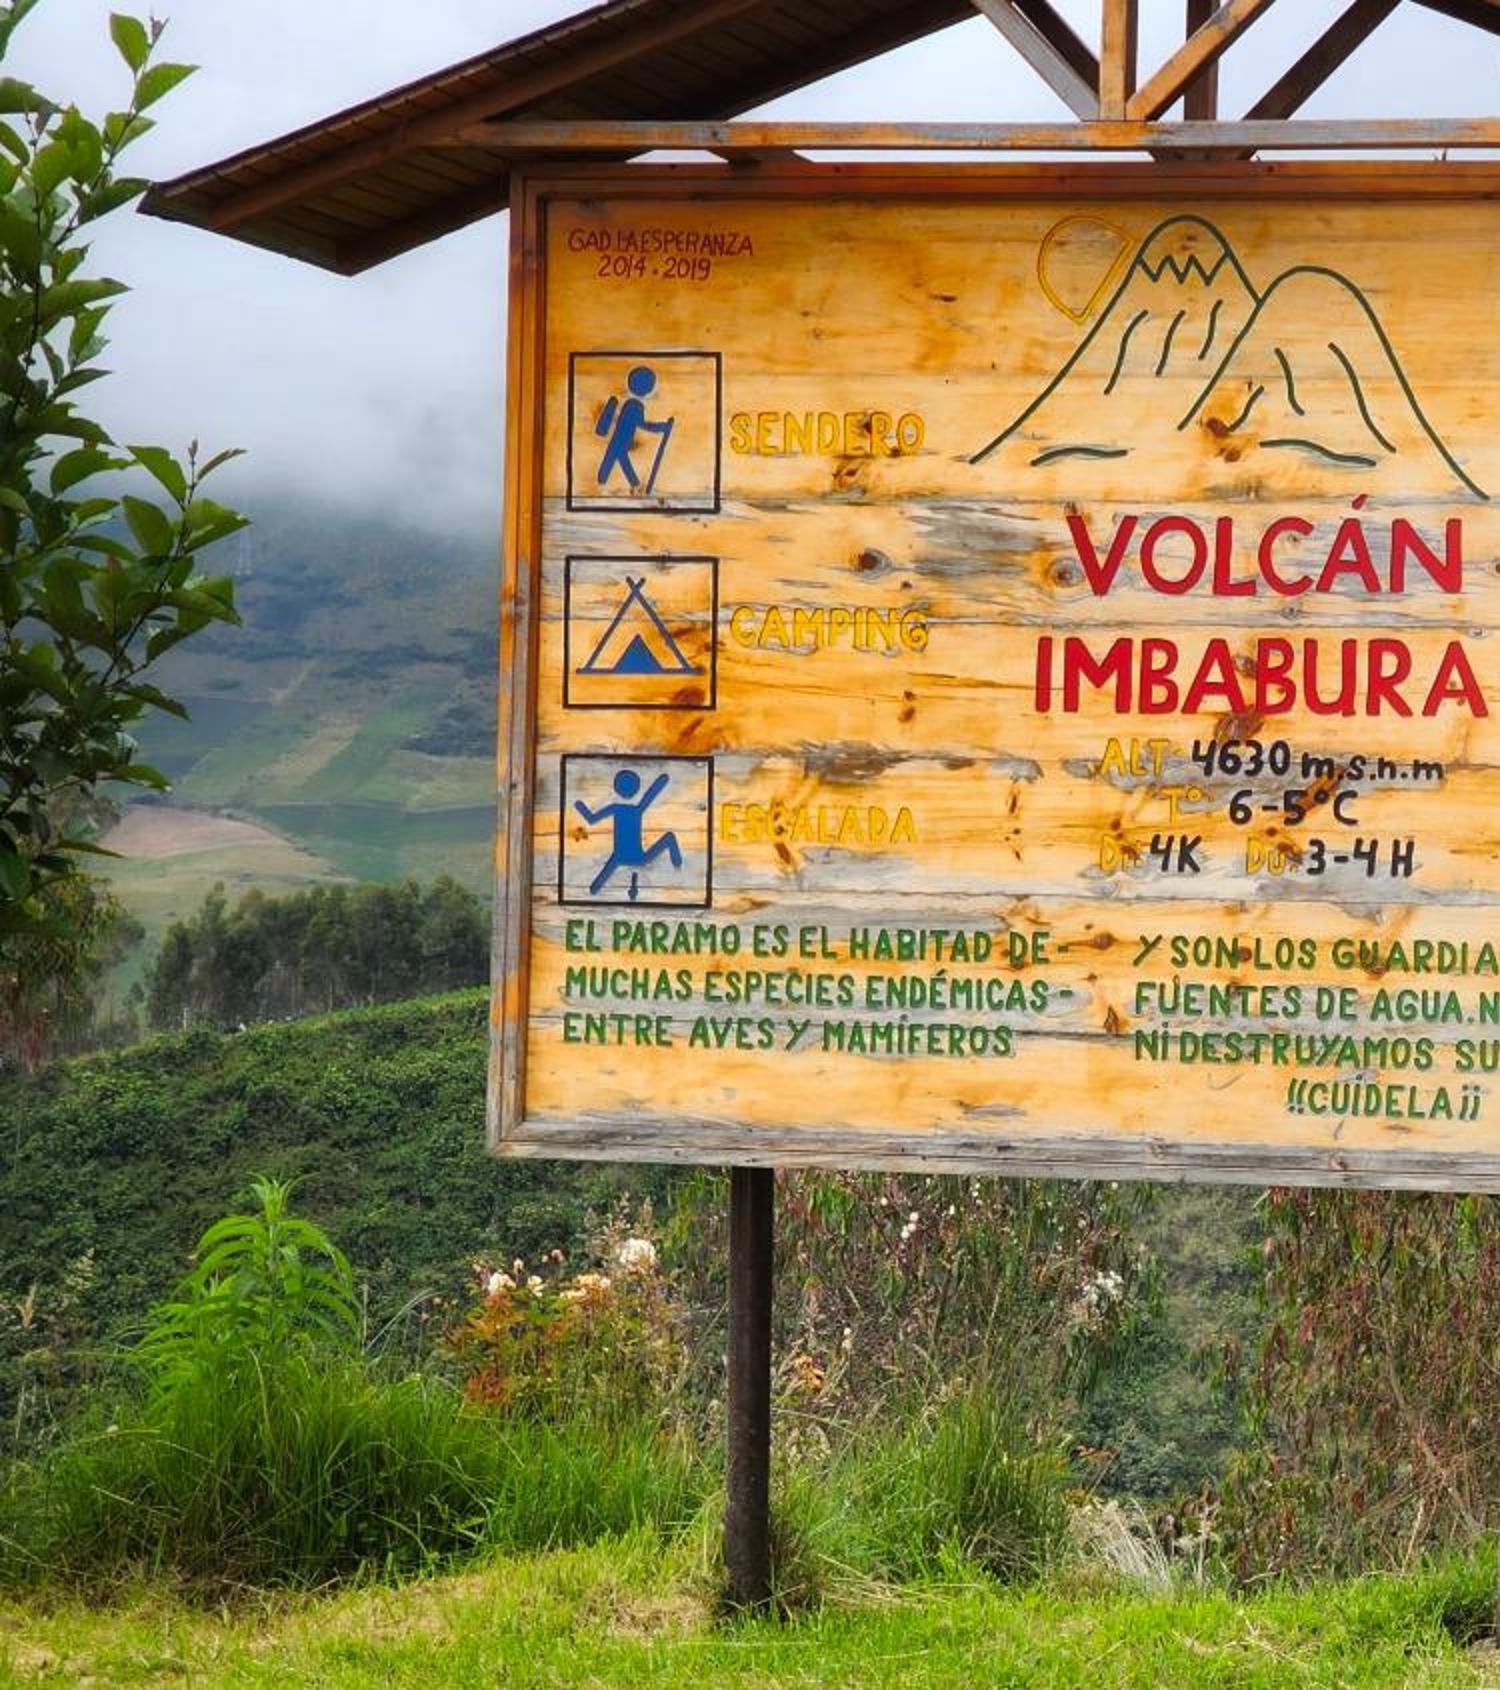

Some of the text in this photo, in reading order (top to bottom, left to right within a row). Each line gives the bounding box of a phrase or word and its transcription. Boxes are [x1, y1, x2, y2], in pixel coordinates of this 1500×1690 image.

[568, 228, 612, 252] GAD
[729, 411, 926, 456] SENDERO
[1065, 493, 1463, 597] VOLCÁN
[730, 606, 930, 653] CAMPING
[1034, 636, 1488, 717] IMBABURA
[1192, 739, 1291, 776] 4630
[720, 803, 917, 844] ESCALADA
[1150, 833, 1202, 872] 4K
[565, 919, 600, 953] EL
[612, 921, 741, 956] PARAMO
[752, 924, 789, 957] ES
[800, 926, 837, 960] EL
[849, 928, 993, 963] HABITAD
[1132, 933, 1164, 966] Y
[1170, 935, 1241, 969] SON
[1253, 937, 1317, 971] LOS
[565, 965, 693, 1000] MUCHAS
[704, 971, 855, 1005] ESPECIES
[1135, 975, 1303, 1018] FUENTES
[1315, 987, 1357, 1020] DE
[562, 1013, 673, 1047] ENTRE
[689, 1018, 775, 1051] AVES
[785, 1019, 809, 1051] Y
[1179, 1030, 1434, 1071] DESTRUYAMOS
[1455, 1039, 1500, 1073] SU
